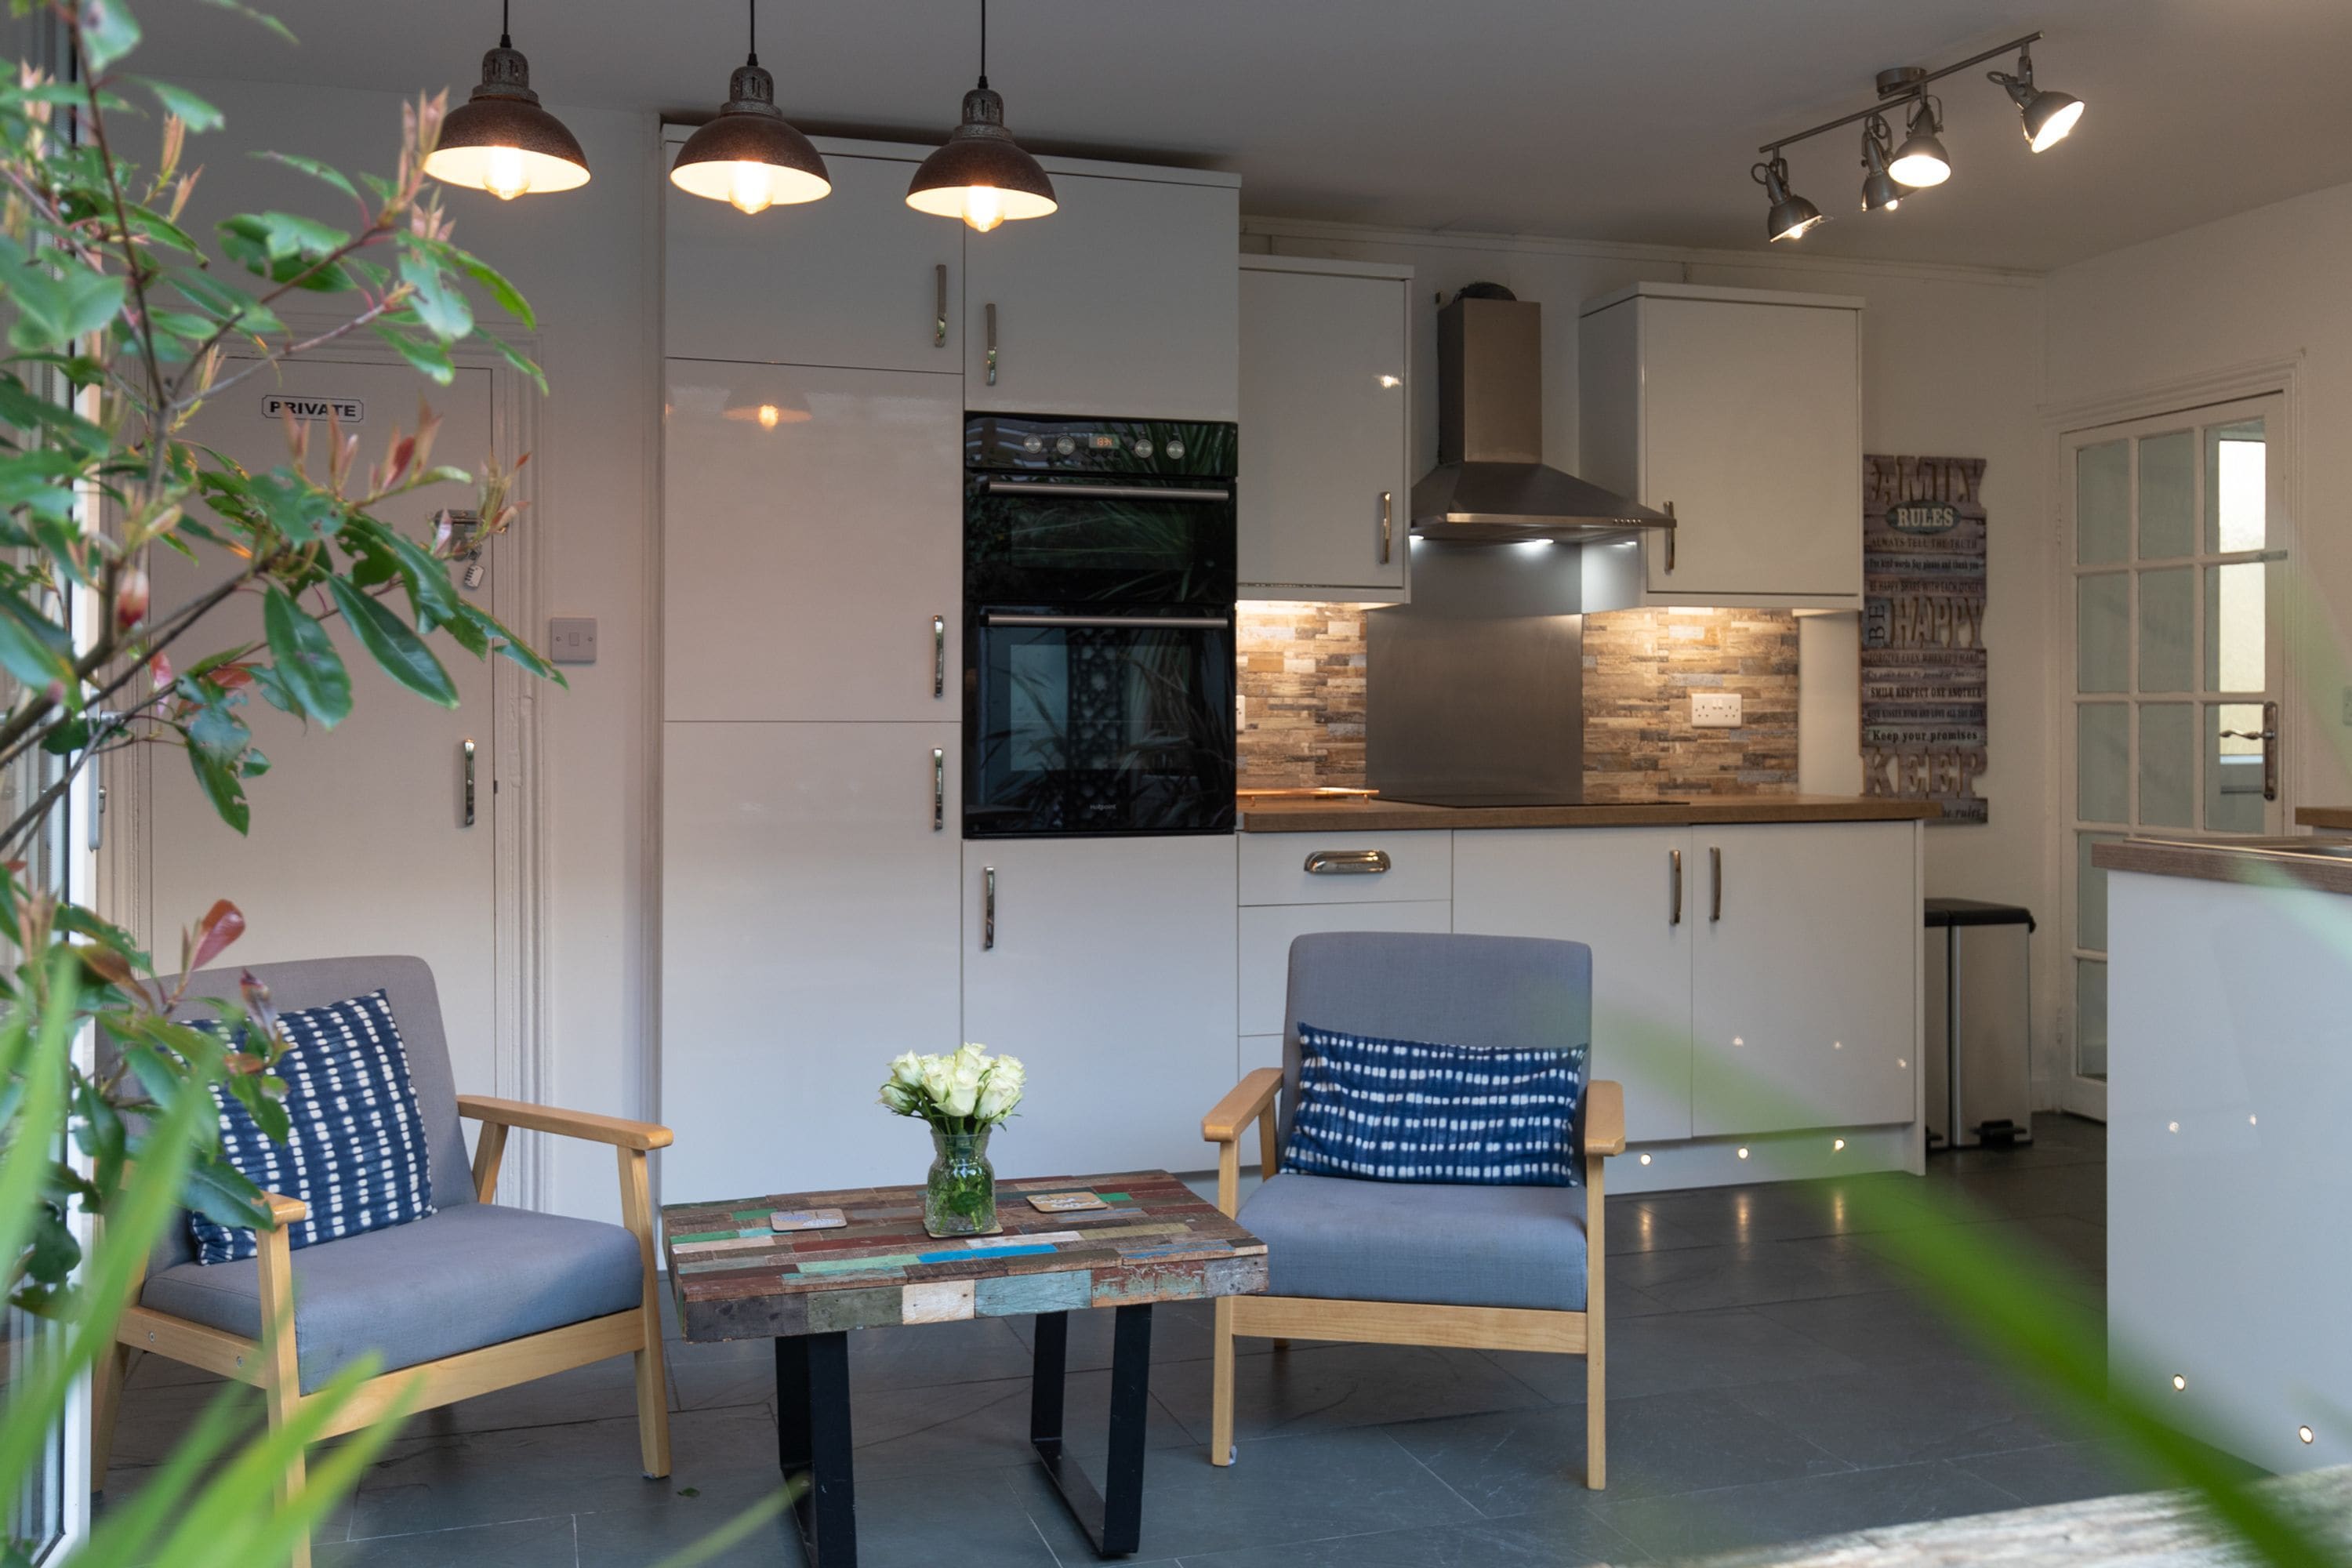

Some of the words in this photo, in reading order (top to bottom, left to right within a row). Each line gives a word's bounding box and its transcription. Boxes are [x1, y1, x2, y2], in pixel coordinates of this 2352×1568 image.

[1896, 507, 1955, 528] RULES
[1871, 538, 1905, 547] ALWAYS
[1908, 538, 1928, 548] TELL
[1931, 539, 1946, 548] THE
[1950, 539, 1976, 549] TRUTH
[1868, 604, 1886, 643] BE
[1890, 597, 1985, 650] HAPPY
[1871, 687, 1894, 698] SMILE
[1896, 687, 1929, 698] RESPECT
[1931, 687, 1946, 698] ONE
[1948, 687, 1983, 698] ANOTHER
[1873, 730, 1900, 743] Keep
[1902, 732, 1927, 743] your
[1930, 730, 1978, 743] promises
[1860, 746, 1988, 799] KEEP
[1955, 805, 1981, 818] rules
